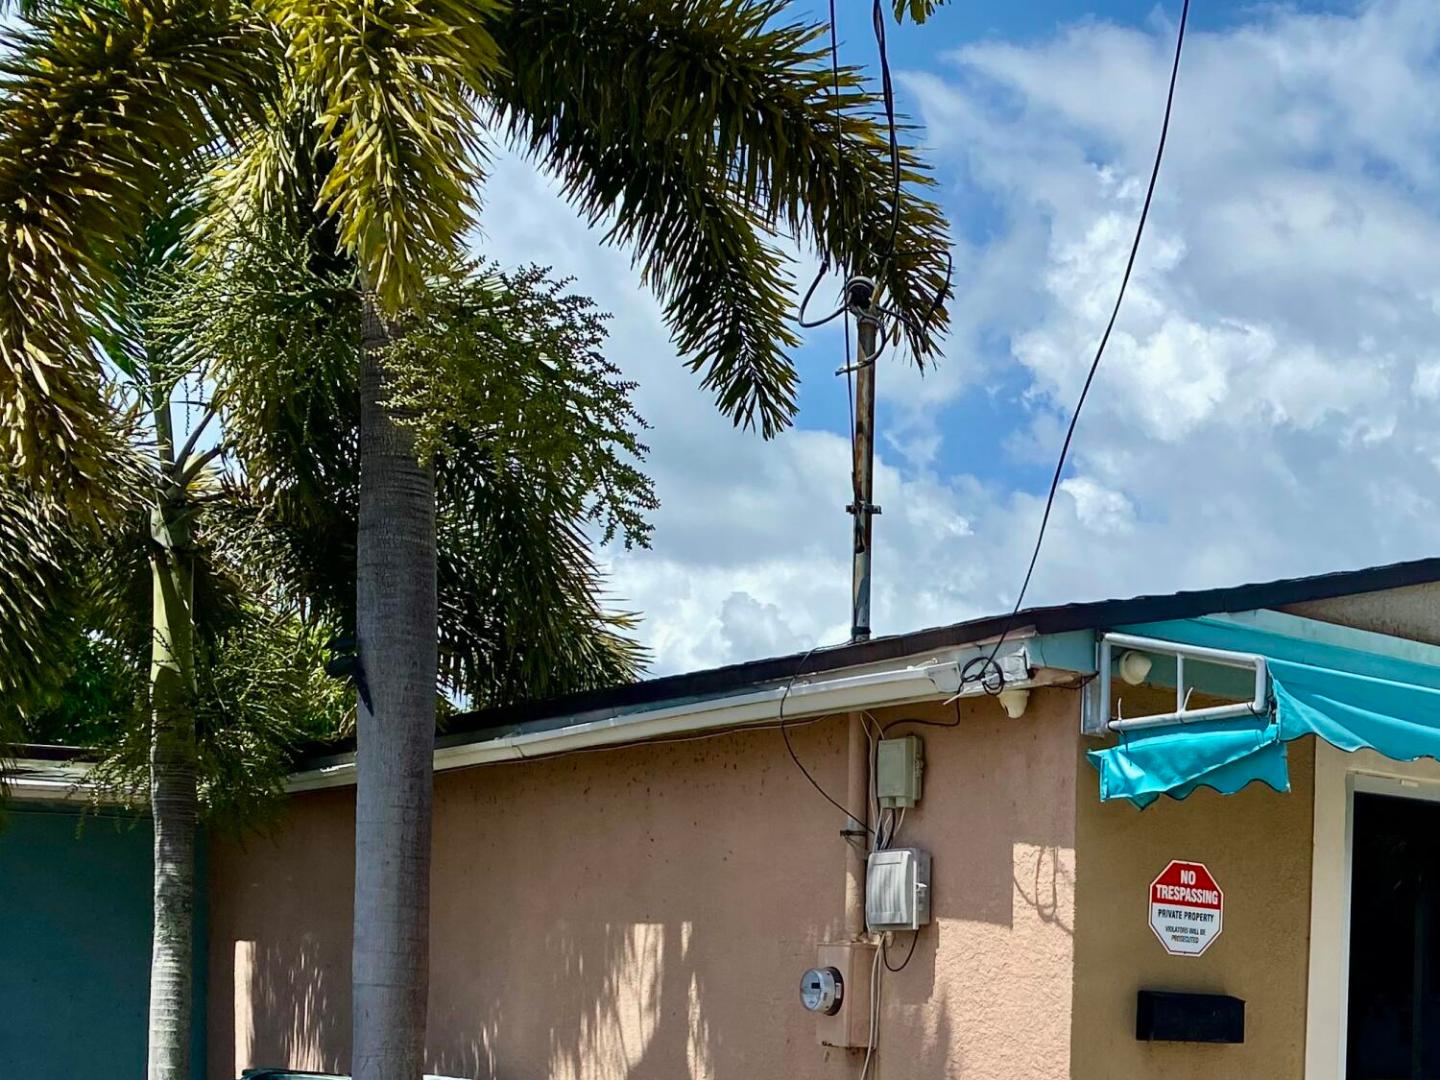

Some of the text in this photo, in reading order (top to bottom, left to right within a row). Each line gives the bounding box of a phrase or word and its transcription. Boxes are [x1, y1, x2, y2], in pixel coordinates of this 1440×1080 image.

[1180, 870, 1196, 885] NO
[1155, 884, 1219, 905] TRESPASSING
[1158, 908, 1215, 923] PRIVATE PROPERTY
